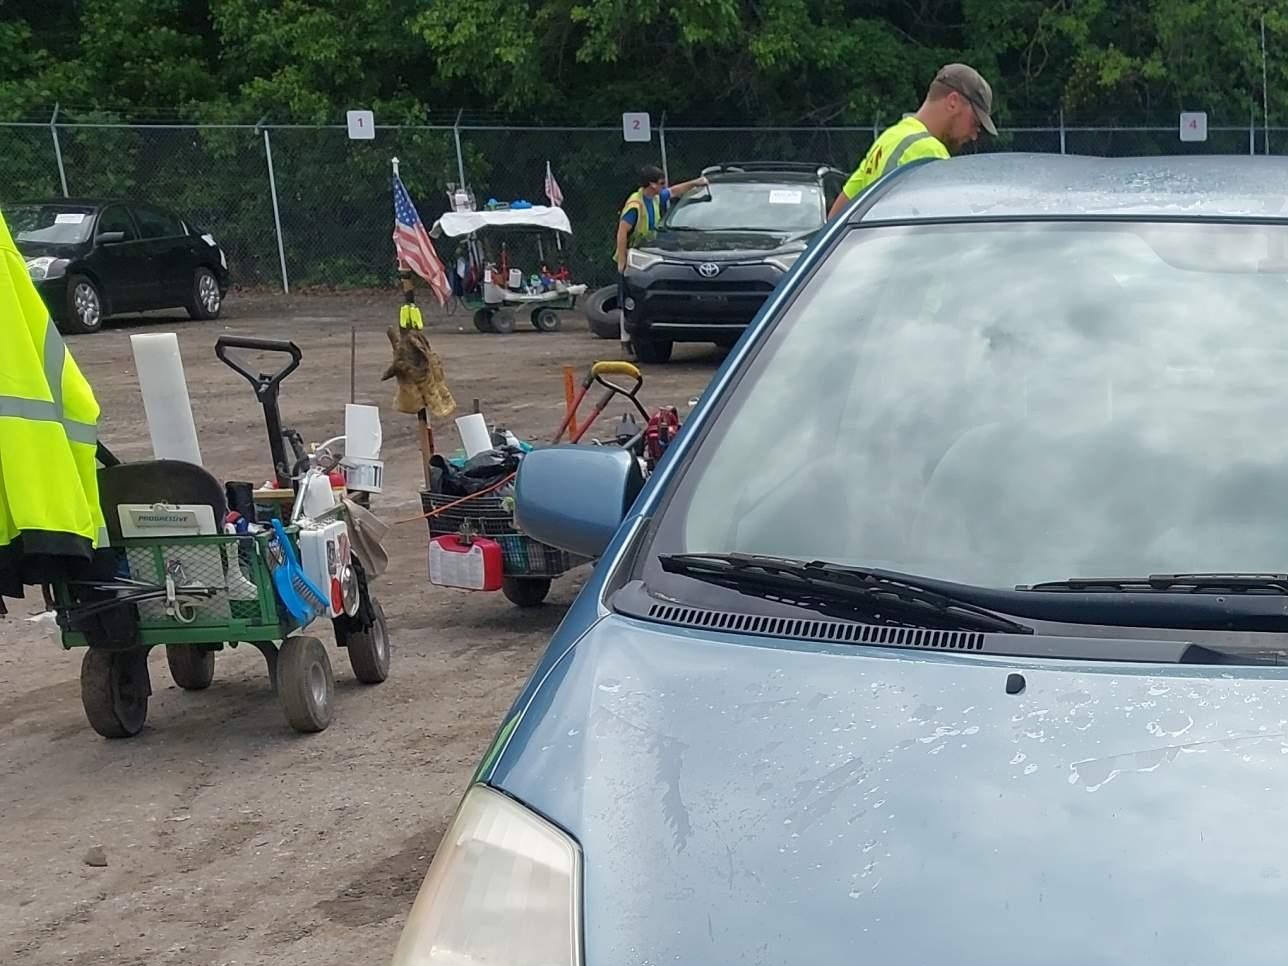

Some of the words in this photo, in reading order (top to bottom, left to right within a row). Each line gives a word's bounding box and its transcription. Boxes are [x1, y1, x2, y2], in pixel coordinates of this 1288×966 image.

[357, 117, 364, 128] 1
[632, 119, 642, 130] 2
[1188, 119, 1198, 129] 4
